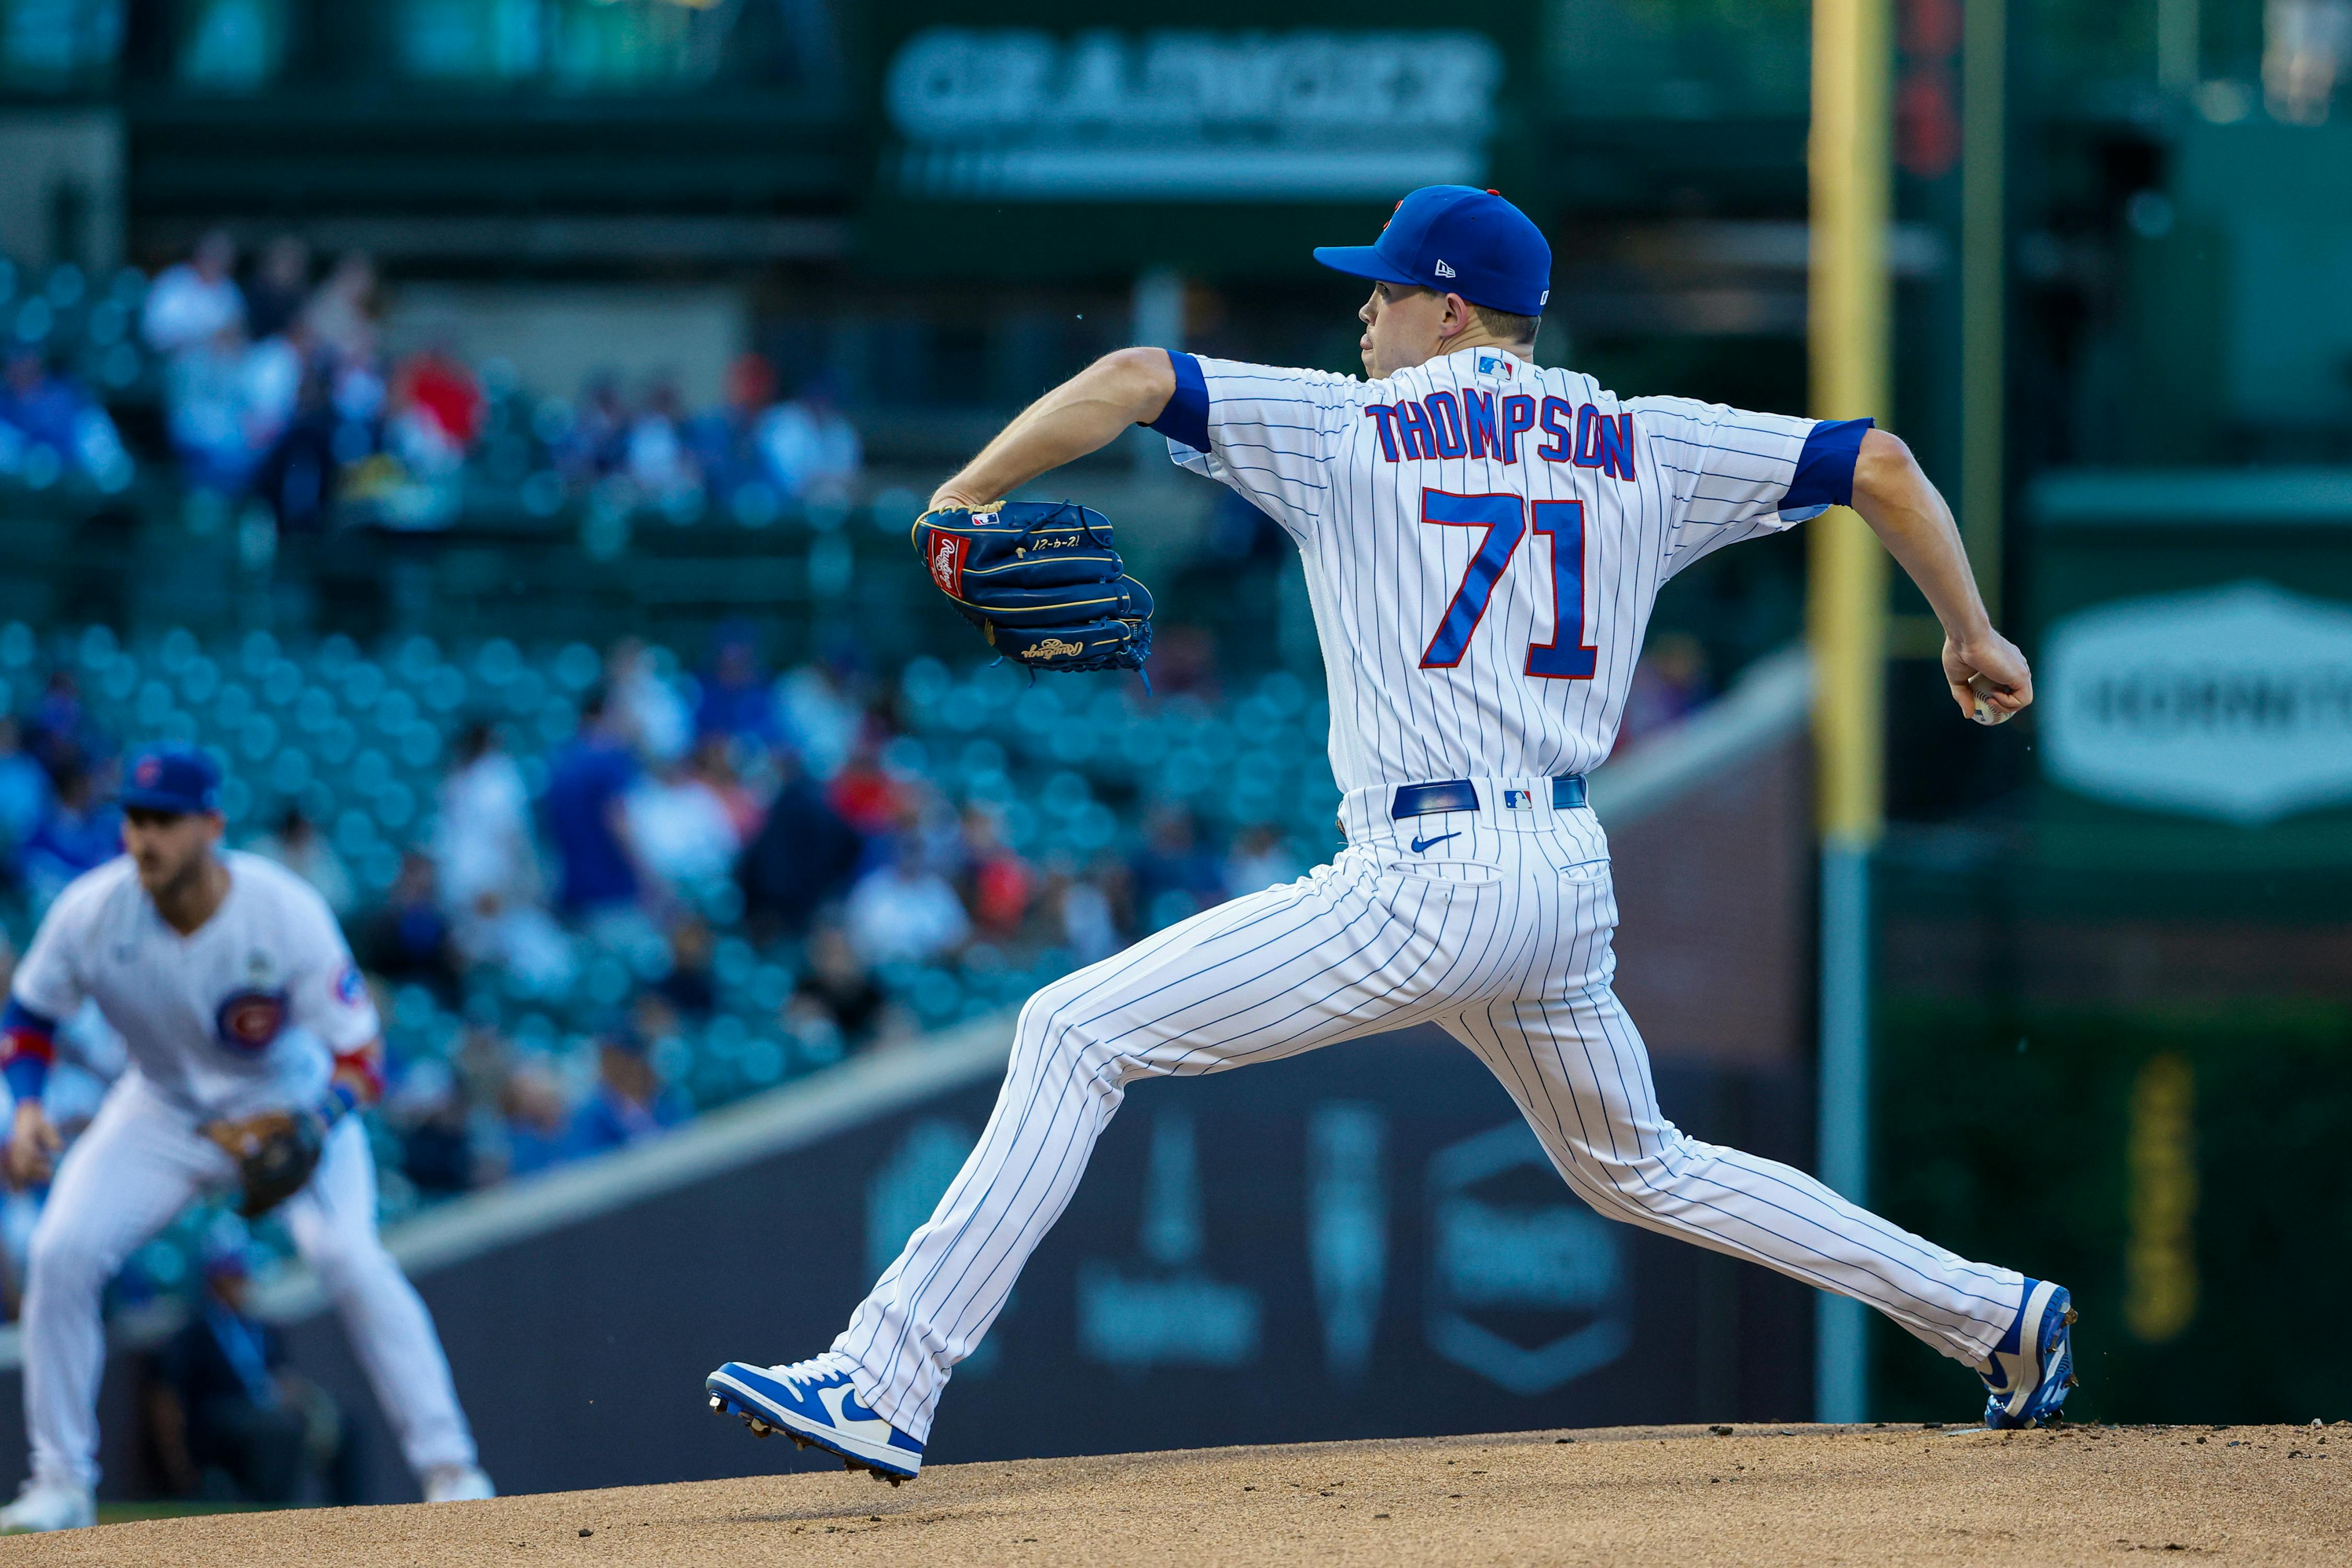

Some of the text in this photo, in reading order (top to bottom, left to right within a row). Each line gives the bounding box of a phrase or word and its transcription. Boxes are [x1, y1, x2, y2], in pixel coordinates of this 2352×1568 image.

[1365, 388, 1635, 482] THOMPSON
[936, 538, 955, 589] Rawlings
[1419, 487, 1597, 679] 71
[1021, 640, 1083, 660] Rawlings
